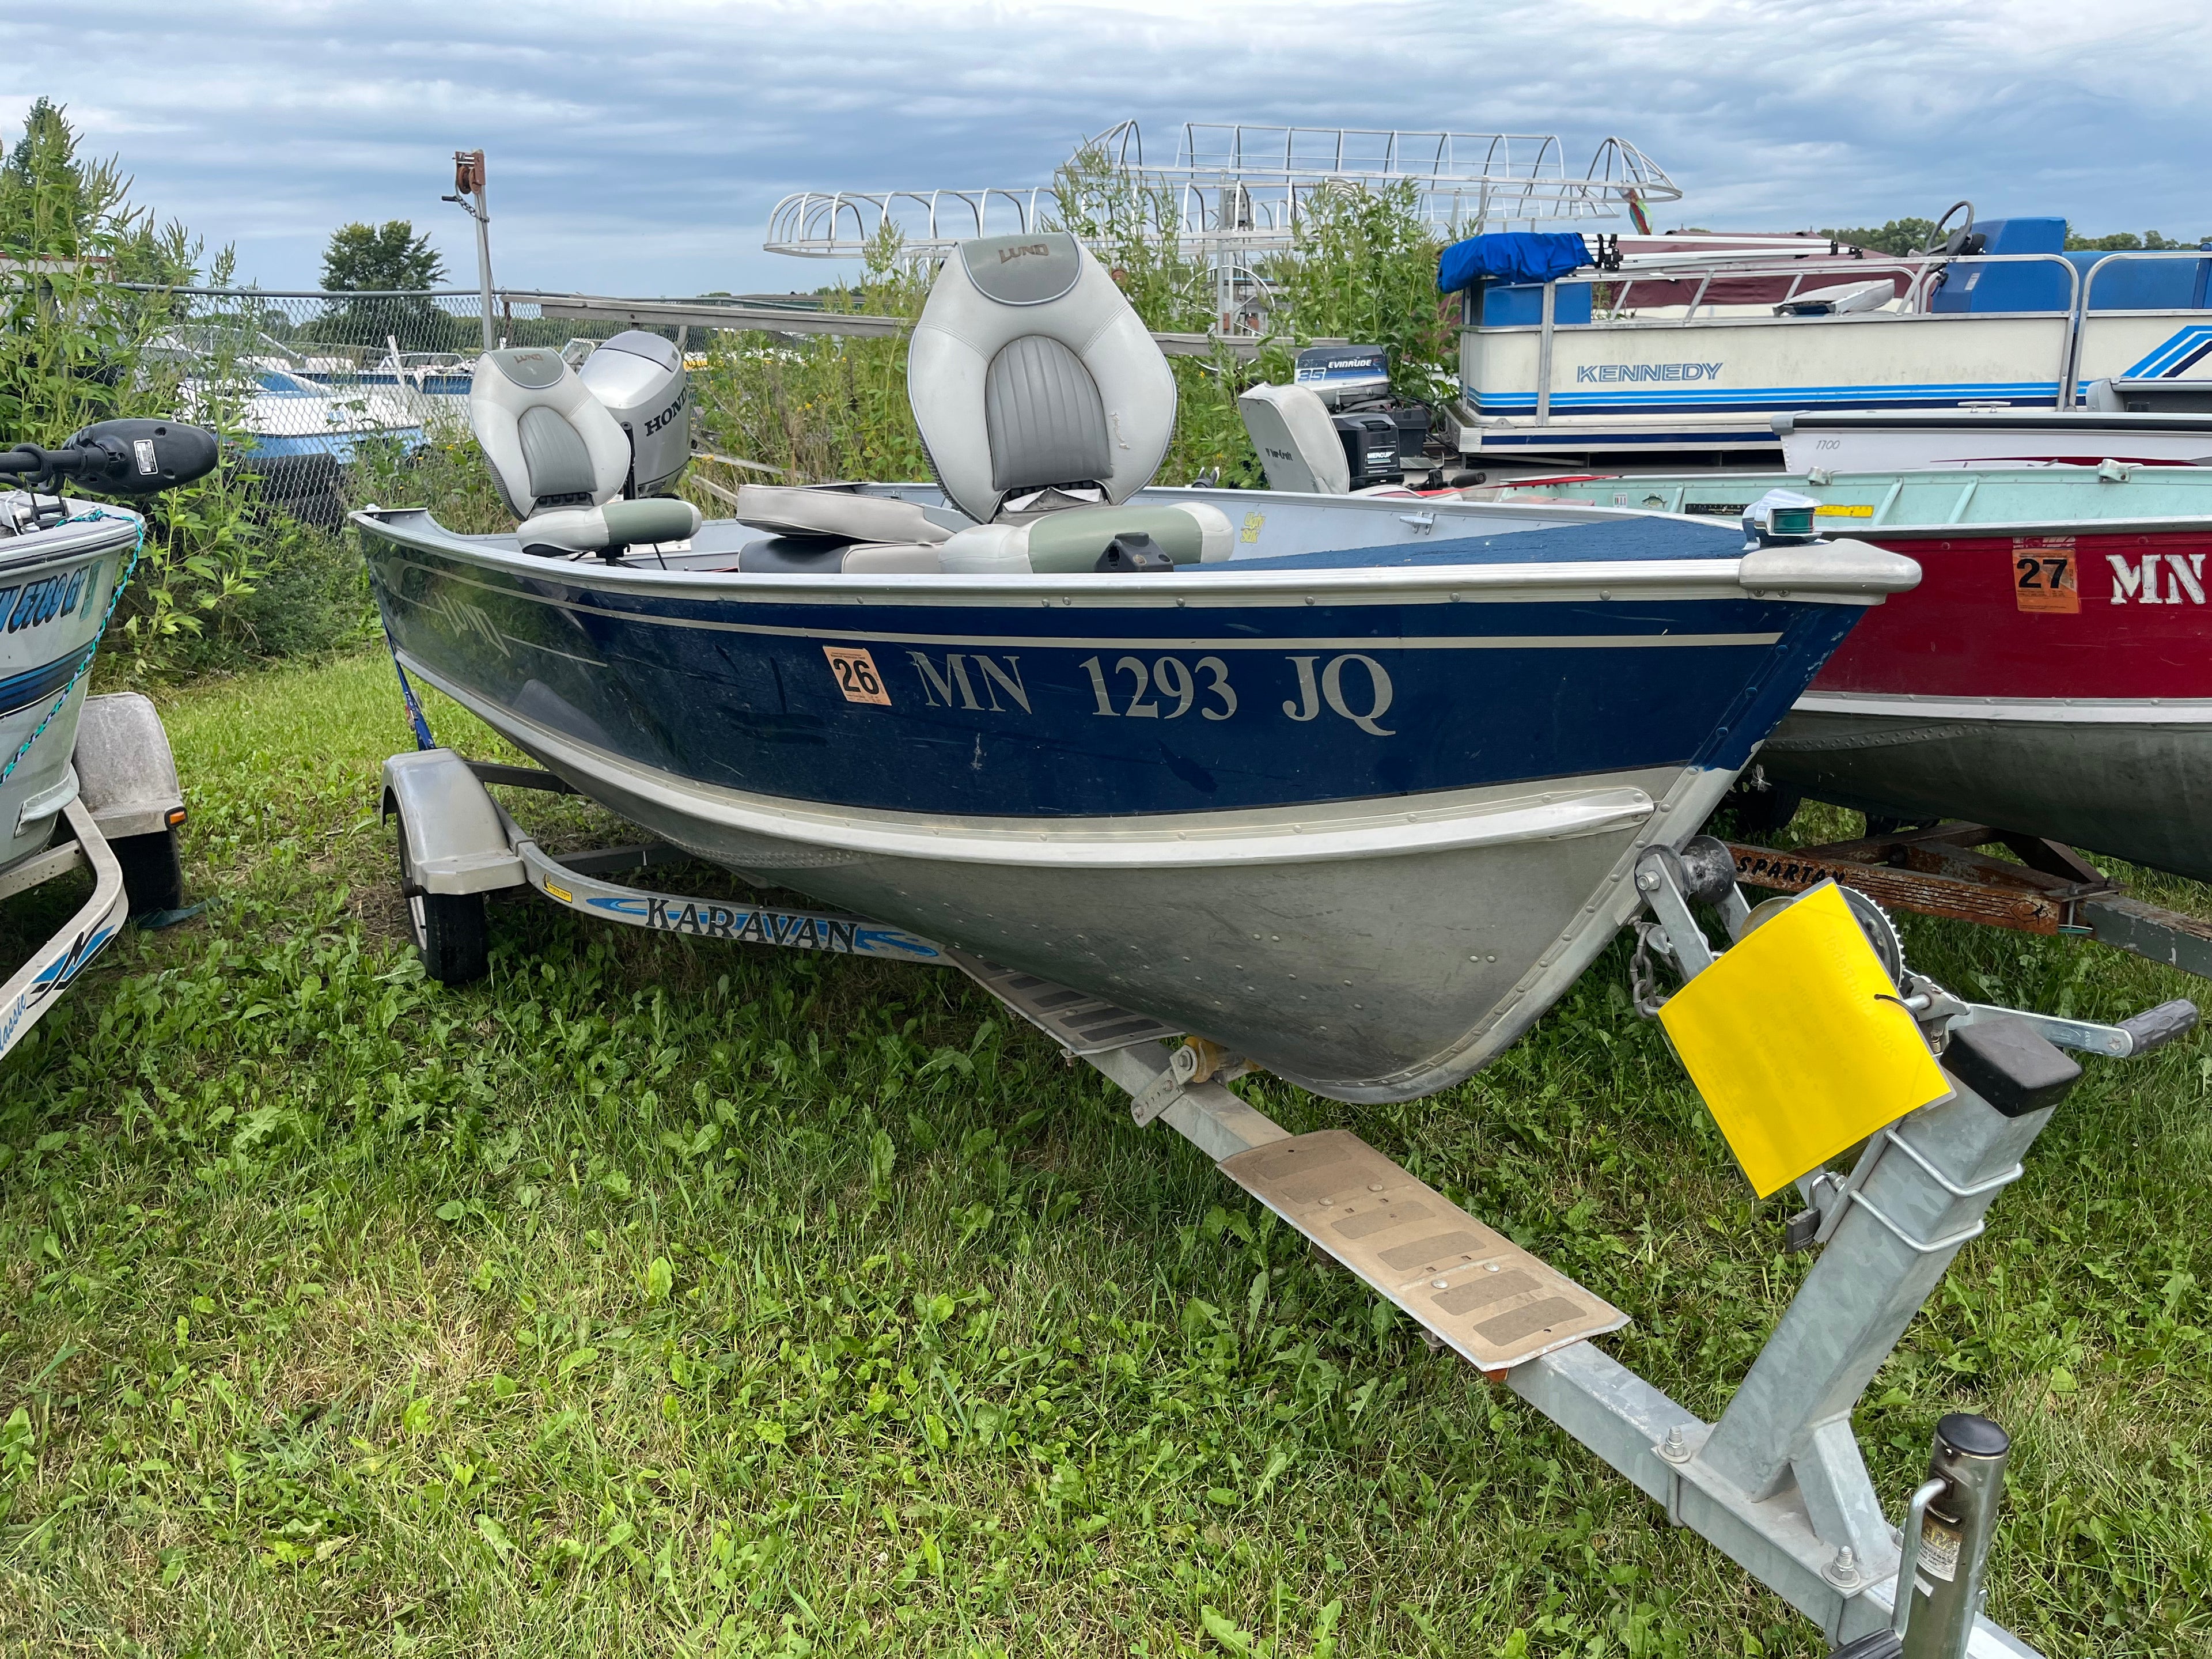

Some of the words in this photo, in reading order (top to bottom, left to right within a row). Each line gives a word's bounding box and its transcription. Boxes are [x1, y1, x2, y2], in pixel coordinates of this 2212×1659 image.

[998, 243, 1049, 264] LUND
[1298, 369, 1325, 381] 35
[1328, 359, 1372, 369] EVINRUDE
[1577, 362, 1723, 382] KENNEDY
[1816, 440, 1840, 451] 1700
[1244, 512, 1266, 529] Ugly
[2017, 558, 2067, 589] 27
[2105, 554, 2206, 605] MN
[7, 573, 67, 634] 5789
[433, 591, 511, 658] LUND
[833, 658, 879, 695] 26
[906, 650, 1032, 714] MN
[1078, 655, 1238, 721] 1293
[1282, 654, 1396, 736] JQ
[645, 897, 857, 954] KARAVAN
